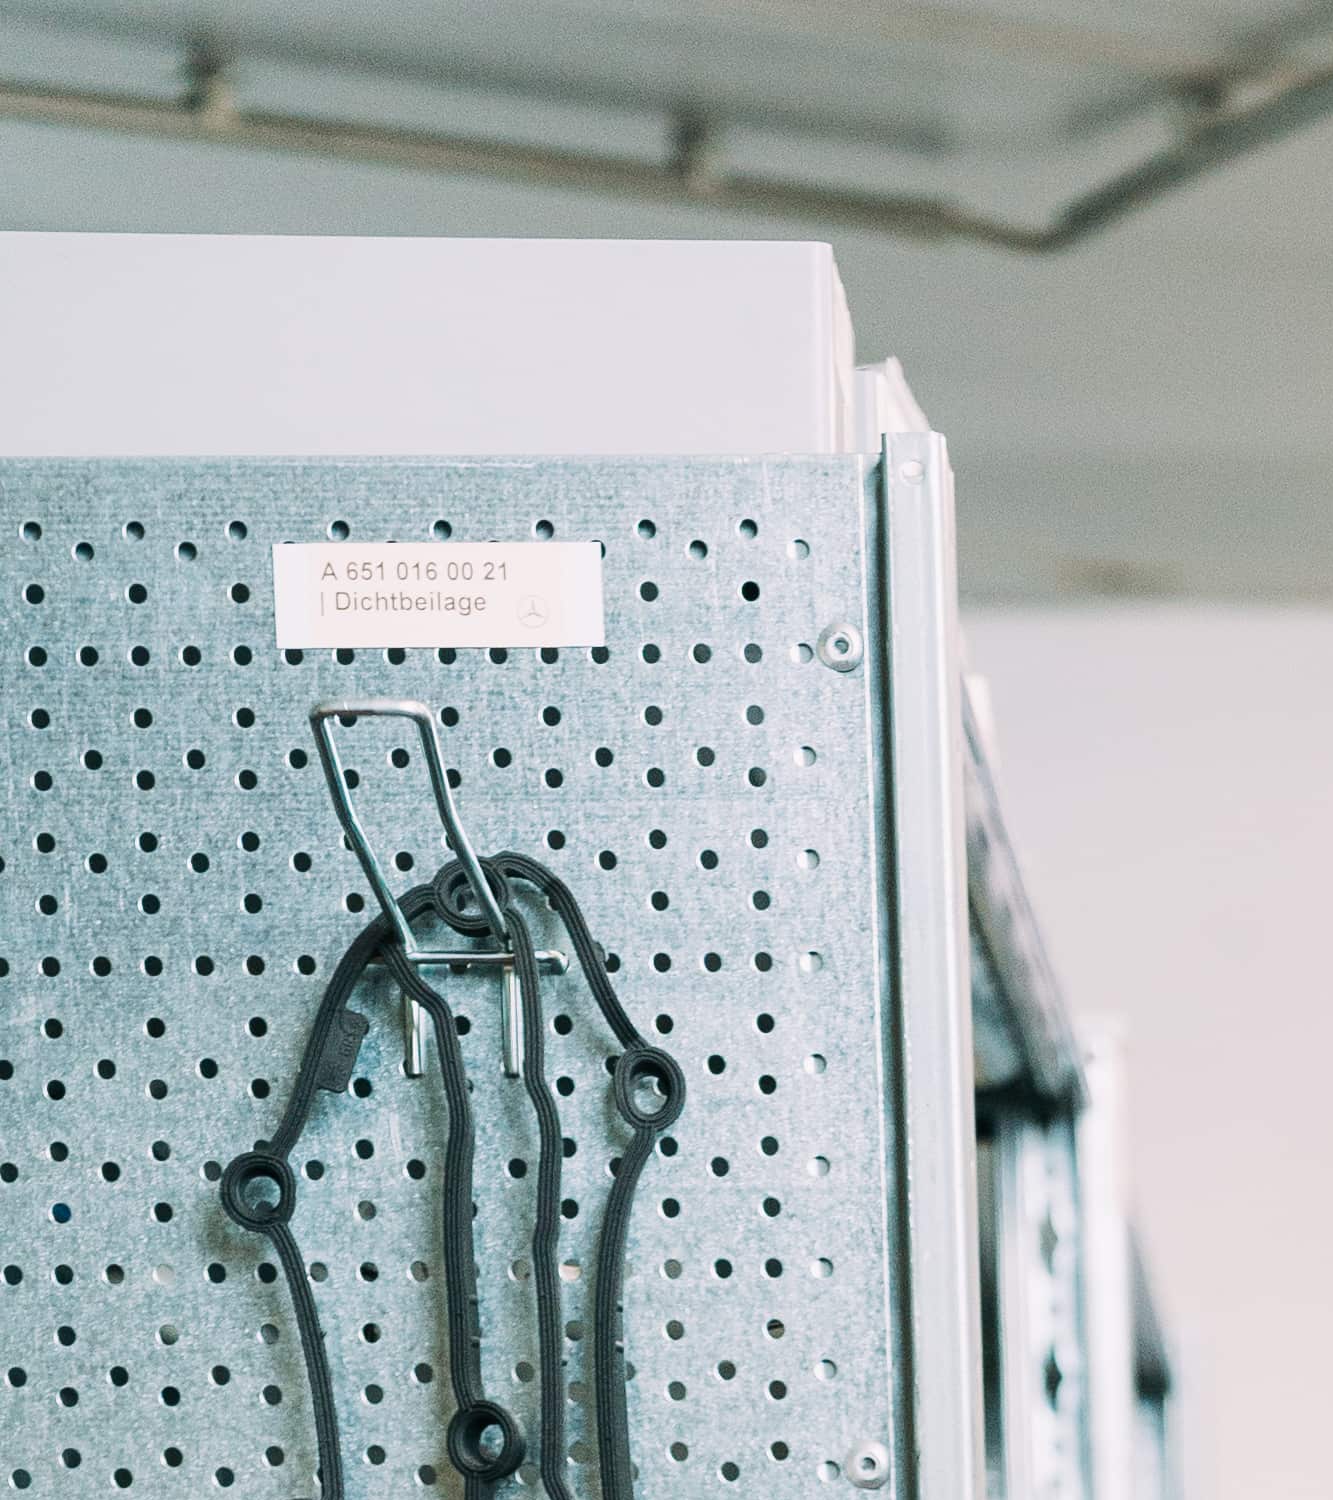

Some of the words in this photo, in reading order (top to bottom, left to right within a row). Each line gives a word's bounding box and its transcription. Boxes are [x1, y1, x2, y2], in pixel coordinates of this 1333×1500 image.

[320, 561, 339, 581] A
[345, 561, 385, 581] 651
[396, 561, 438, 581] 016
[446, 561, 474, 581] 00
[482, 561, 508, 581] 21
[335, 591, 487, 617] Dichtbeilage
